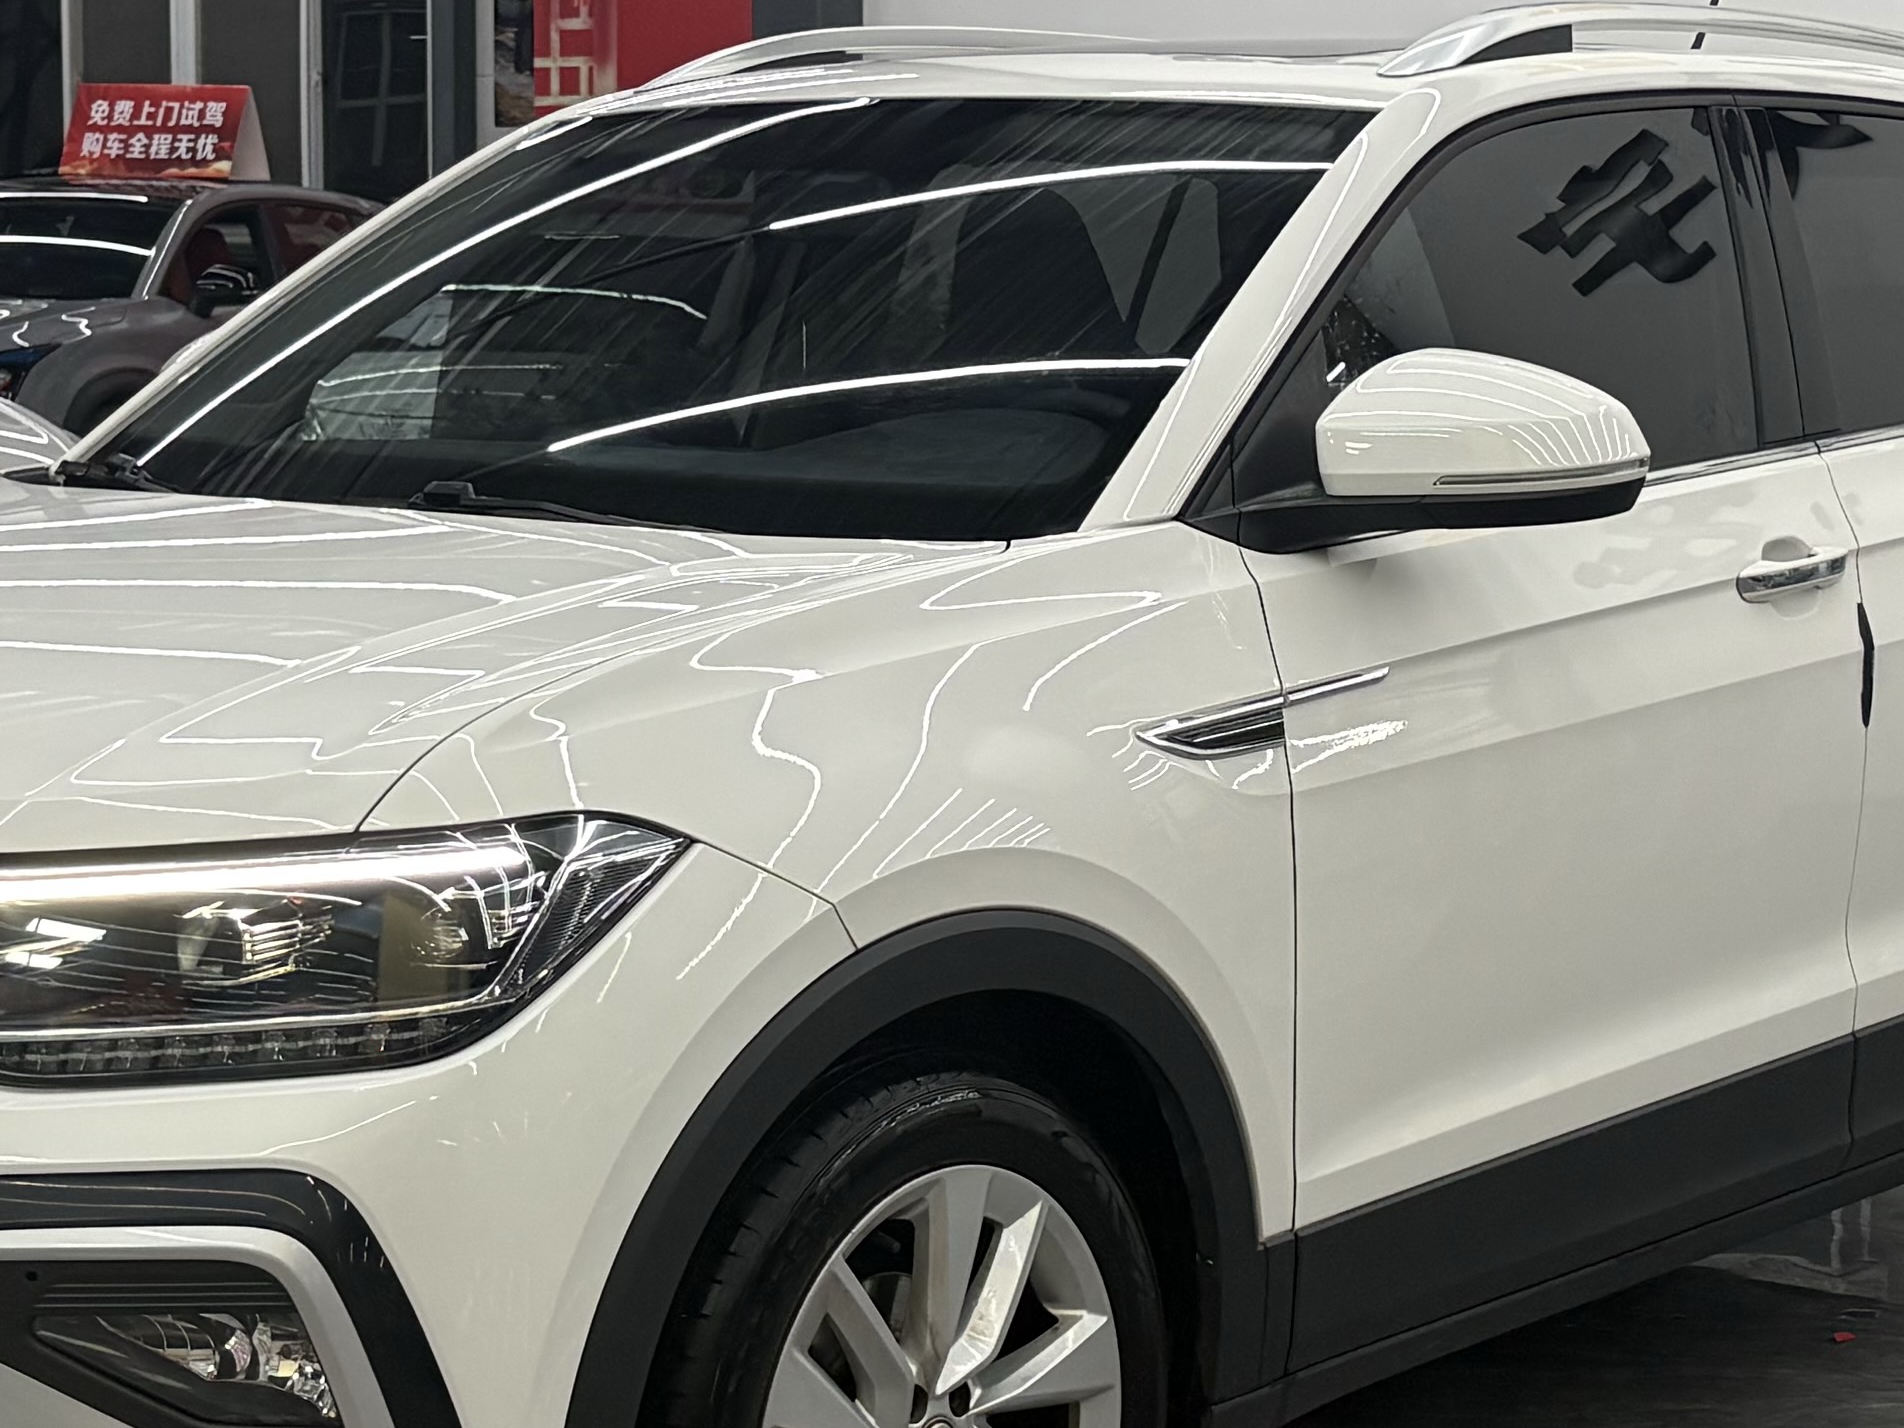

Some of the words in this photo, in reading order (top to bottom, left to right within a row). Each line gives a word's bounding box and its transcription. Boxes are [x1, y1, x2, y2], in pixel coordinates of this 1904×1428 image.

[86, 99, 228, 129] 免费上门试驾
[79, 131, 219, 161] 购车全程无忧
